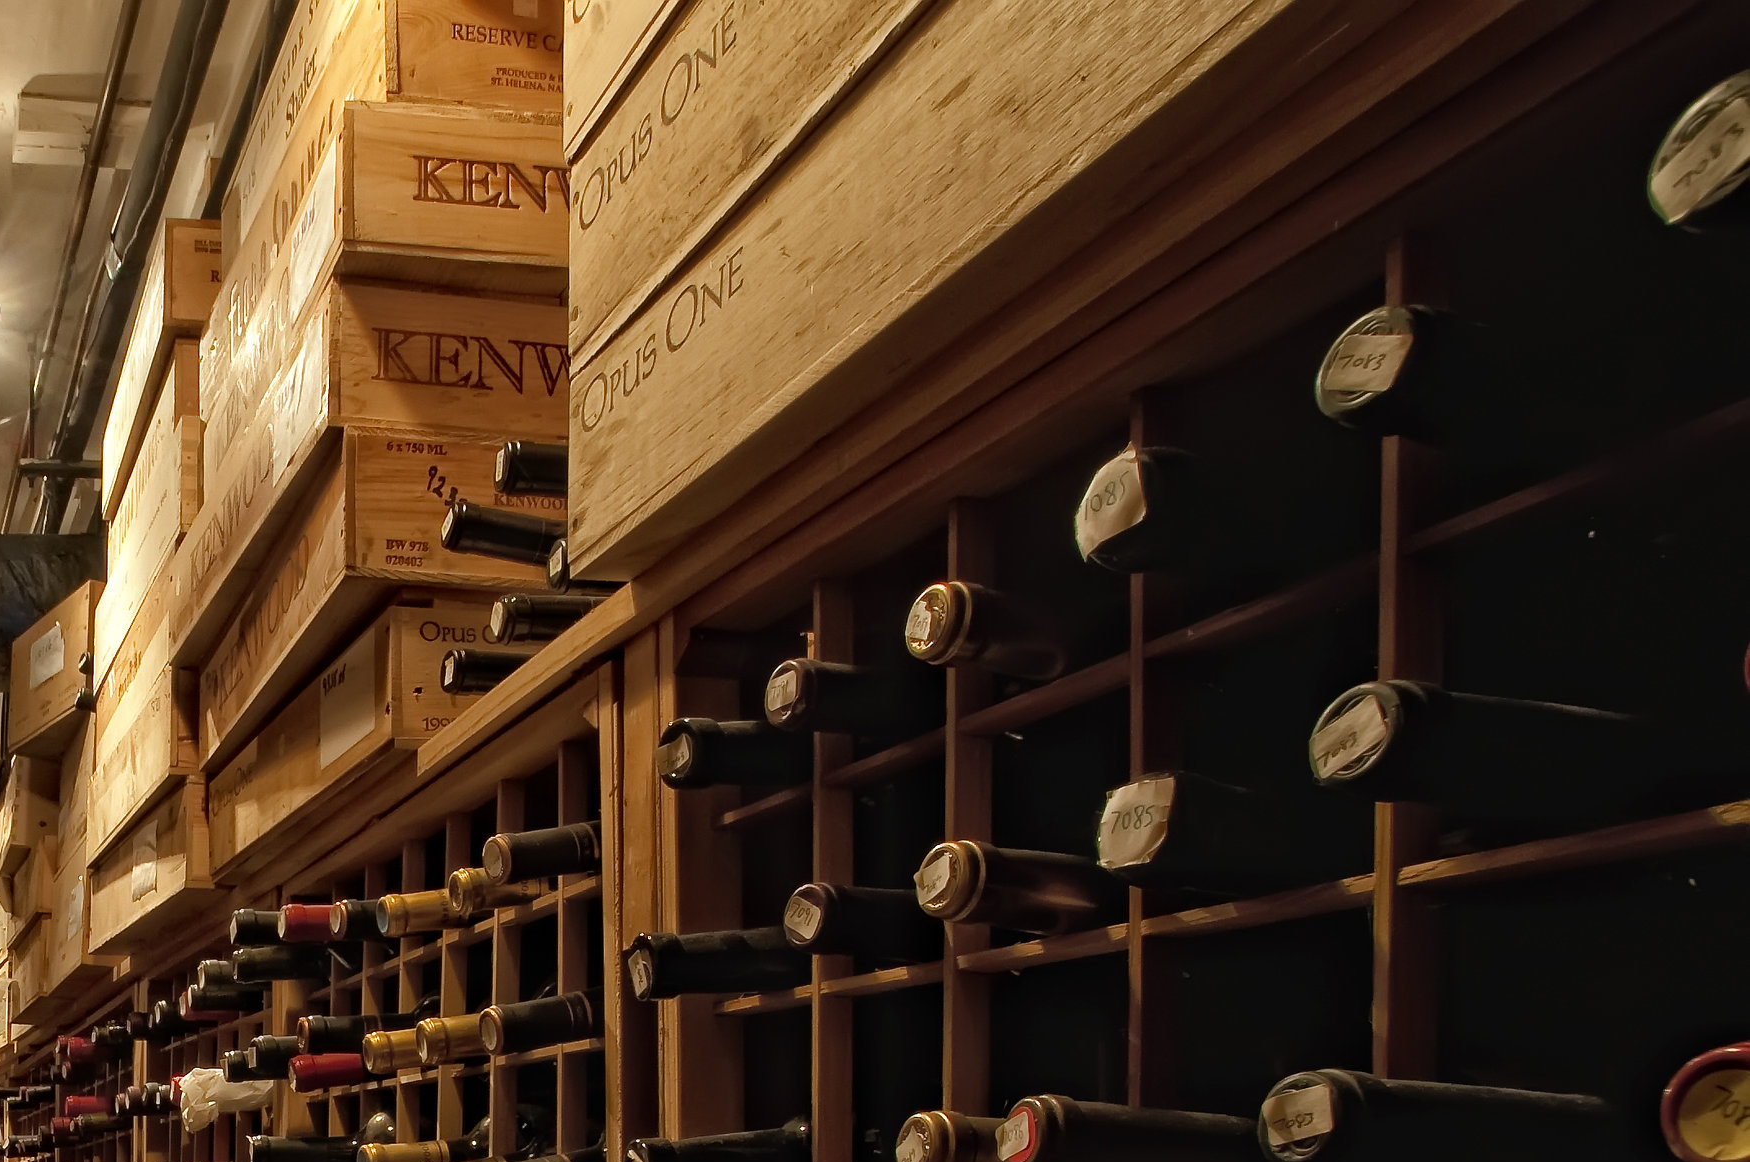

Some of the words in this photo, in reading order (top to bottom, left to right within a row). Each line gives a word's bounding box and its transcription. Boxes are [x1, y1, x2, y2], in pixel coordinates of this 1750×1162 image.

[451, 23, 538, 50] RESERVE
[495, 67, 547, 81] PRODUCED
[547, 84, 563, 94] NA
[1338, 352, 1388, 374] 7083
[386, 440, 394, 452] 6
[405, 441, 425, 454] 750
[426, 443, 448, 457] ML
[385, 539, 406, 551] BW
[408, 540, 430, 552] 978
[1110, 804, 1156, 836] 7085
[790, 901, 816, 927] 7091
